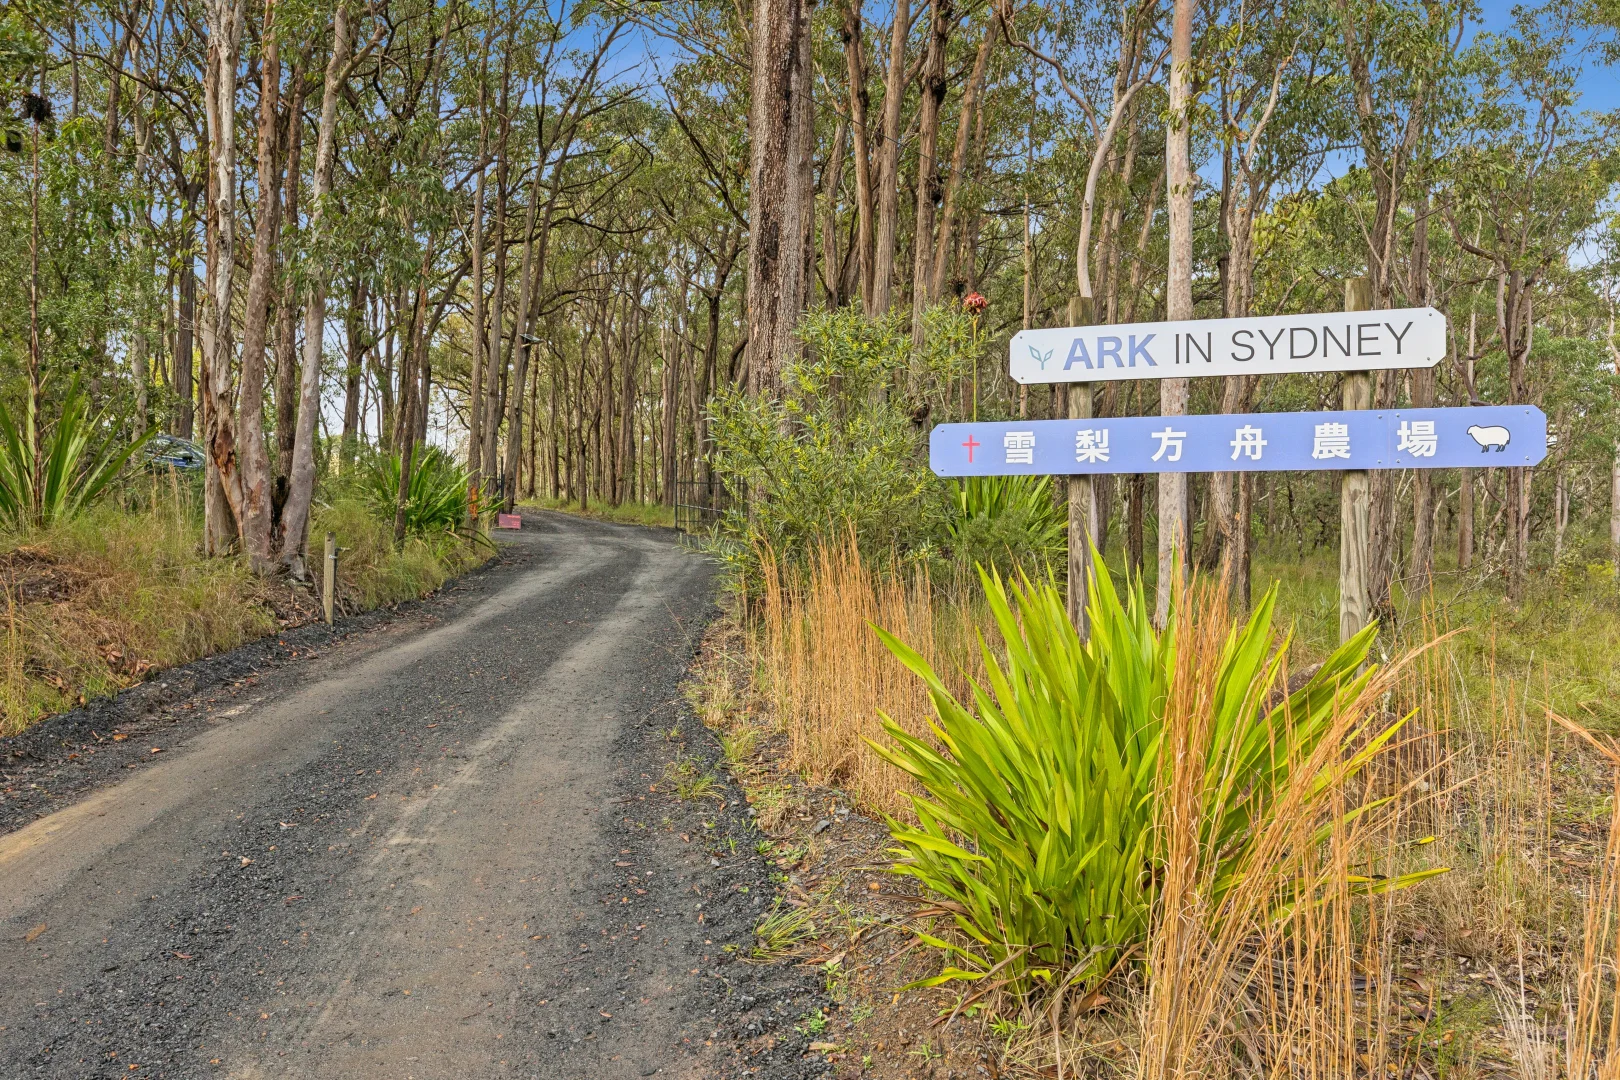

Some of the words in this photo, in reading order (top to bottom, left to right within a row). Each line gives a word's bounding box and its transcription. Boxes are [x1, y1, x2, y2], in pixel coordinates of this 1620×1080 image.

[1063, 333, 1158, 370] ARK
[1175, 332, 1211, 364] IN
[1231, 321, 1413, 362] SYDNEY
[1003, 420, 1438, 464] 雪梨方舟農場
